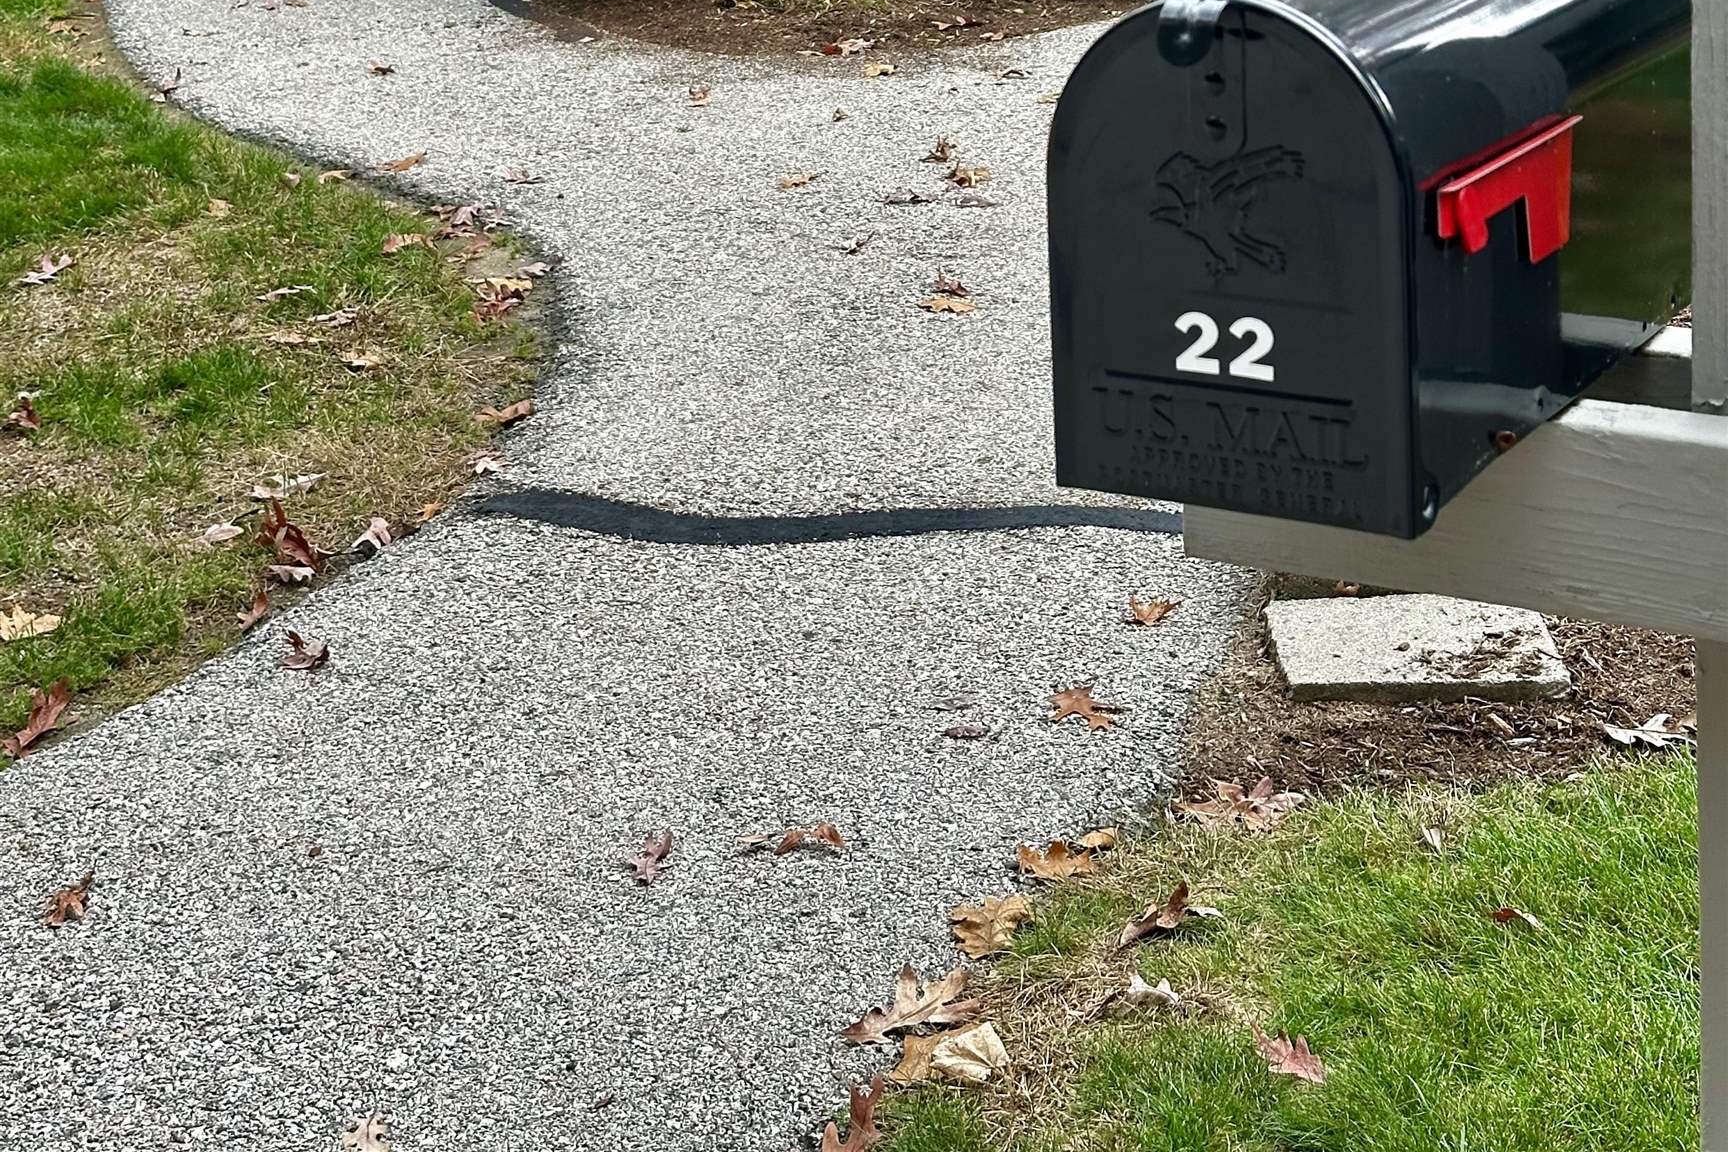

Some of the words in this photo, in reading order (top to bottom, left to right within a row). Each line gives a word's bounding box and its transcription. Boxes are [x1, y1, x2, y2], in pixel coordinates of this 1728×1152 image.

[1174, 311, 1275, 382] 22
[1091, 386, 1189, 441] U.S.
[1205, 401, 1370, 469] MAIL
[1129, 444, 1247, 480] APPROVED
[1256, 461, 1284, 482] BY
[1291, 466, 1336, 492] THE
